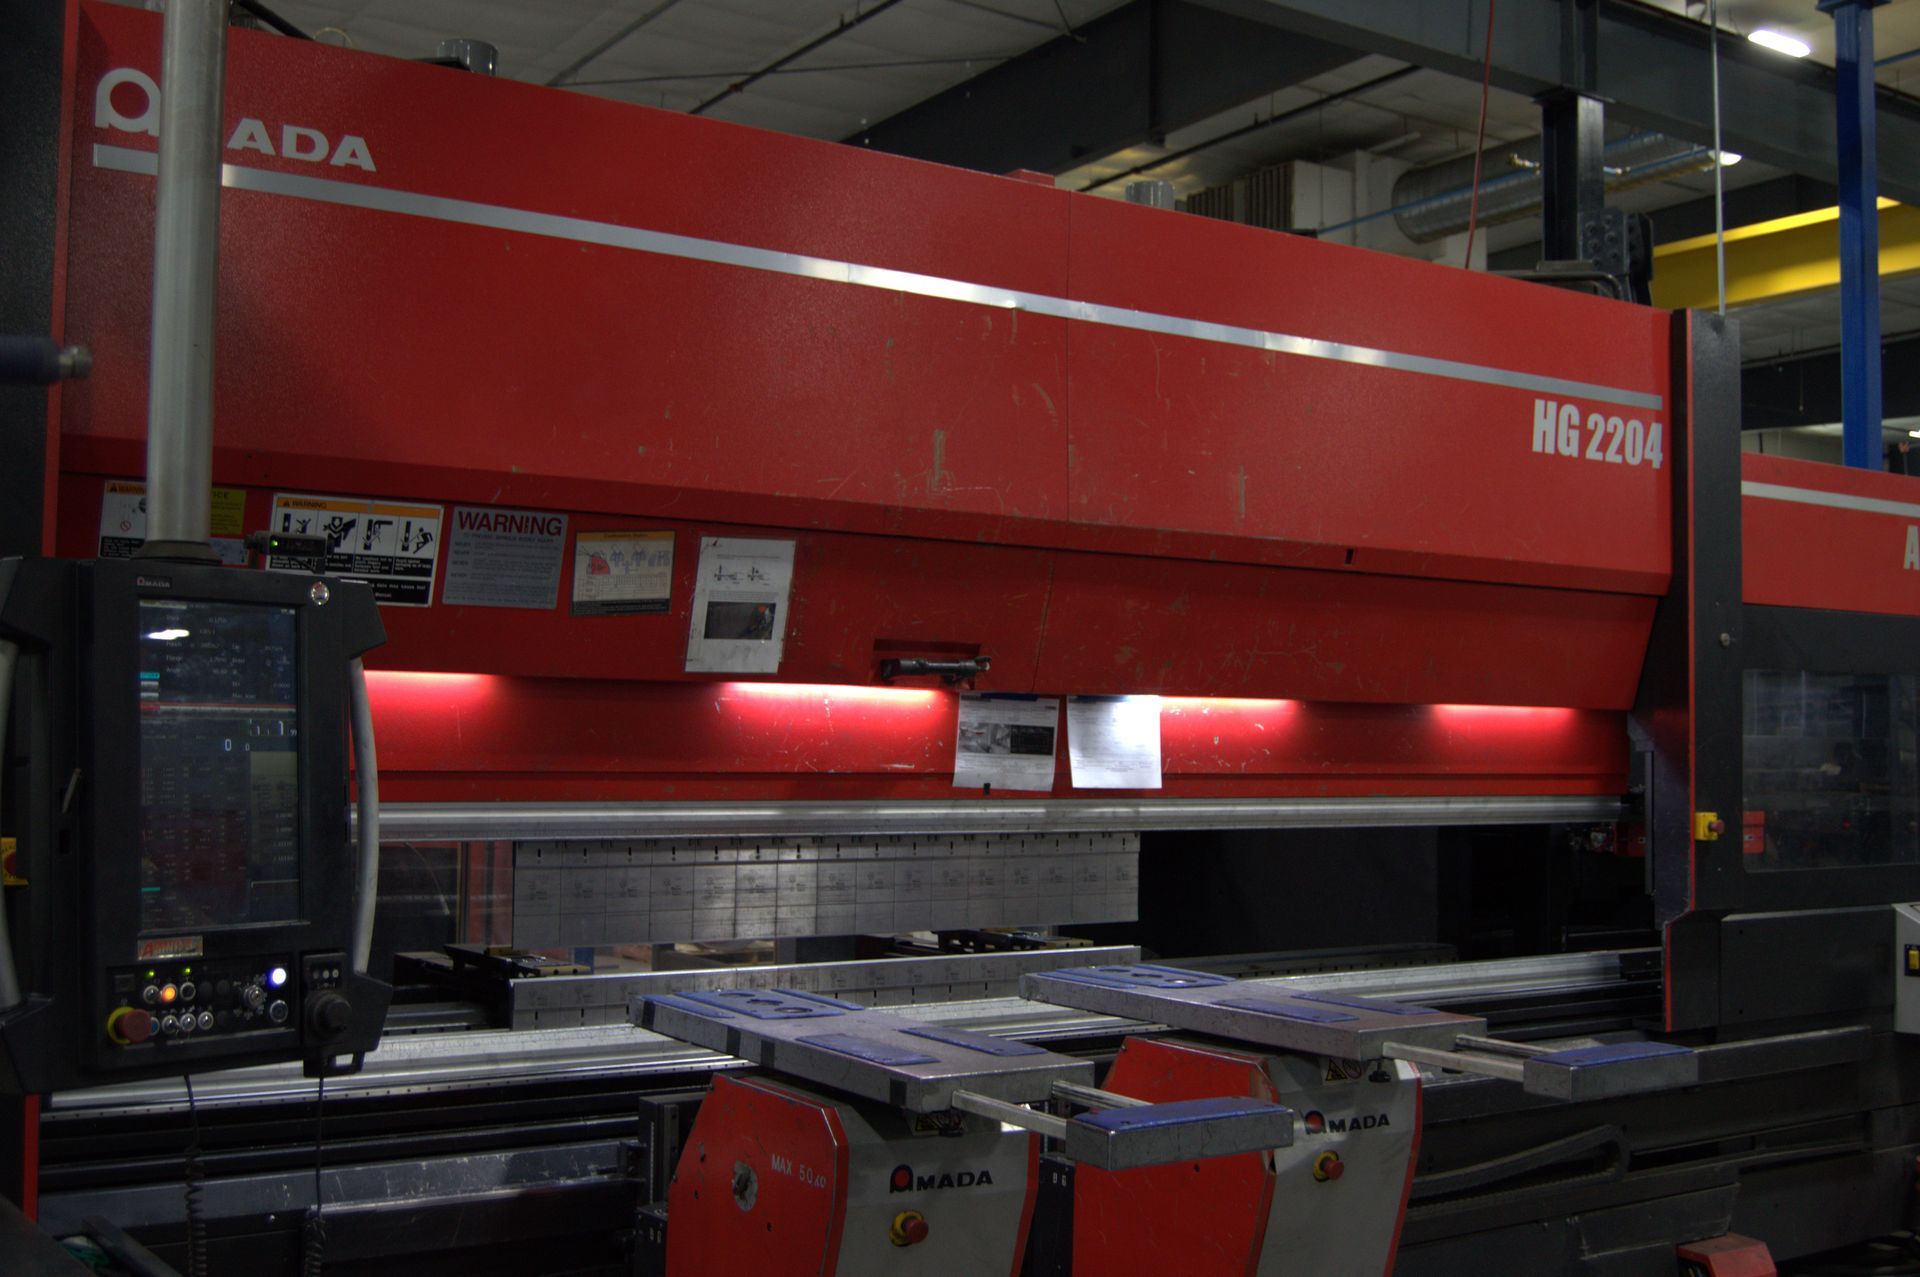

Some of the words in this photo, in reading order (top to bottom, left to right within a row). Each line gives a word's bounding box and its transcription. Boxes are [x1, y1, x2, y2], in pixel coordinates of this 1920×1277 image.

[95, 68, 376, 172] AADA
[1532, 398, 1580, 458] HG
[1585, 412, 1663, 470] 2204
[457, 510, 563, 537] WARNING
[1304, 1110, 1390, 1135] AMADA
[771, 1152, 793, 1176] MAX
[889, 1164, 994, 1193] AMADA
